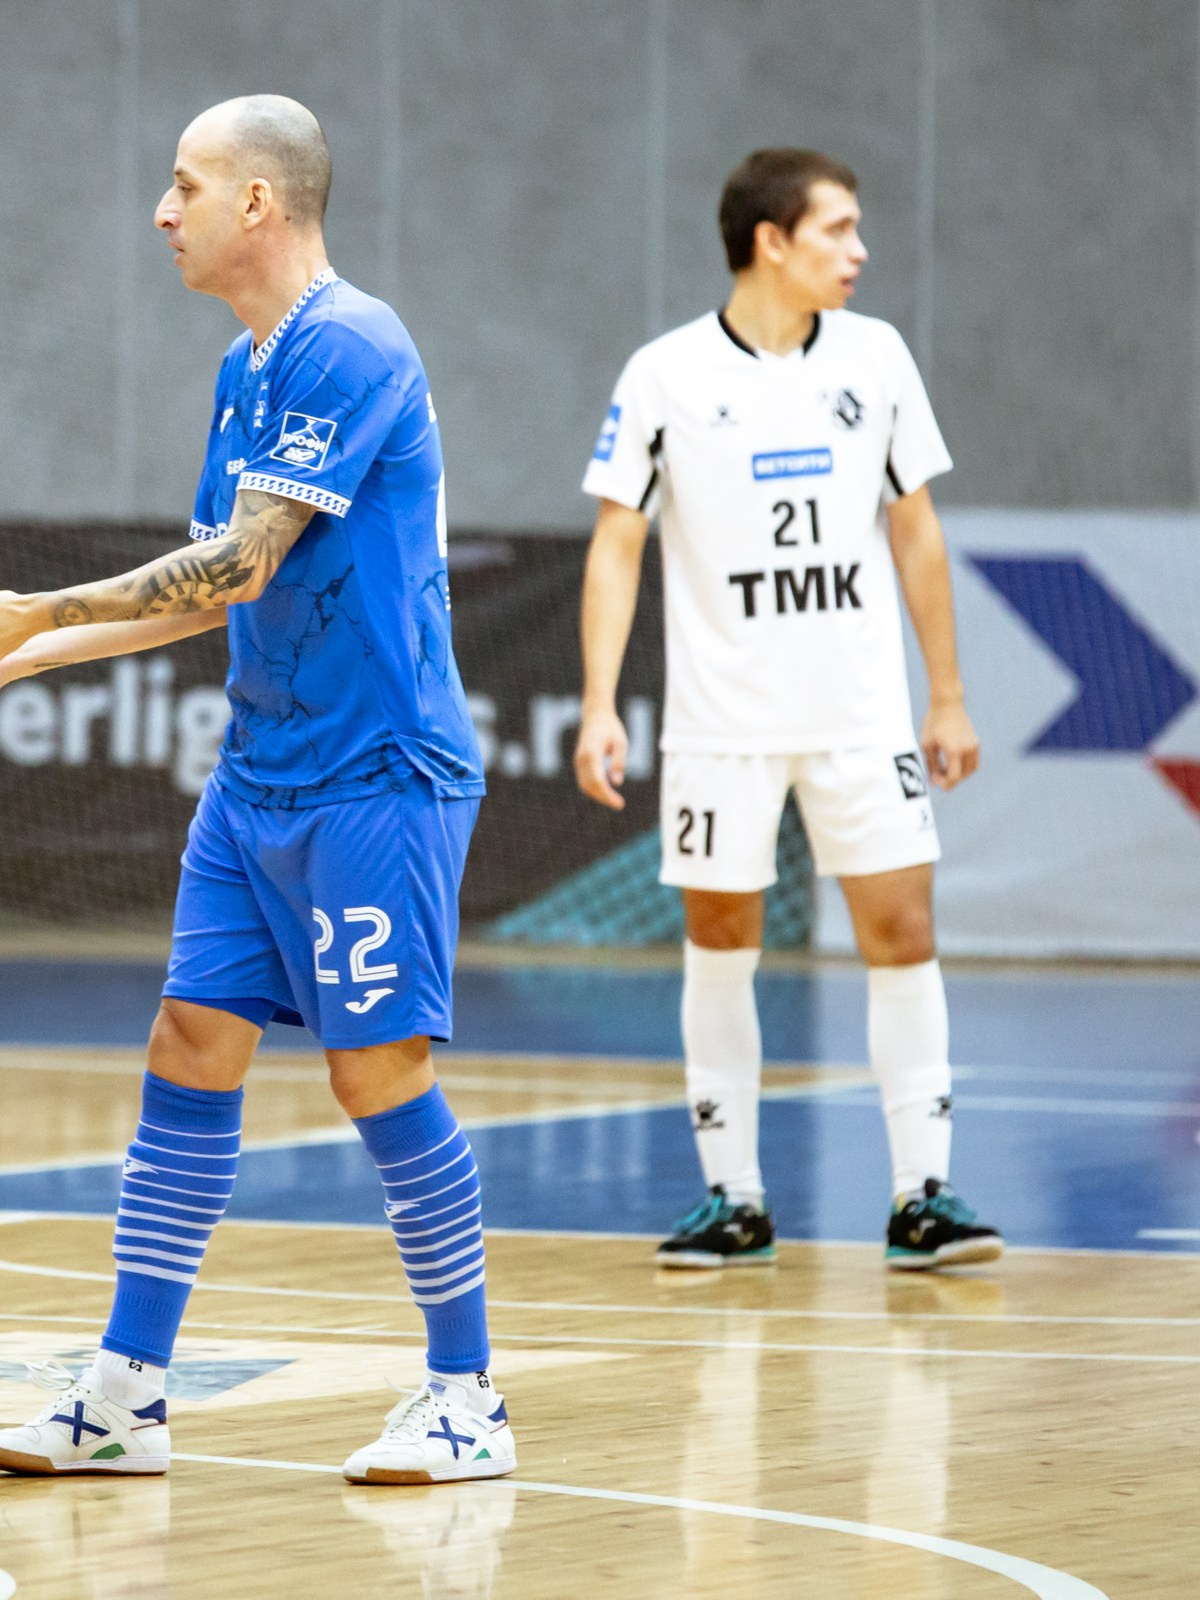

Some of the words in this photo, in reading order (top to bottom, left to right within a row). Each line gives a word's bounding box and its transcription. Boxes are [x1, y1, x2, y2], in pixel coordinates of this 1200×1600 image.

[772, 498, 821, 548] 21
[678, 807, 715, 858] 21
[312, 906, 398, 984] 22
